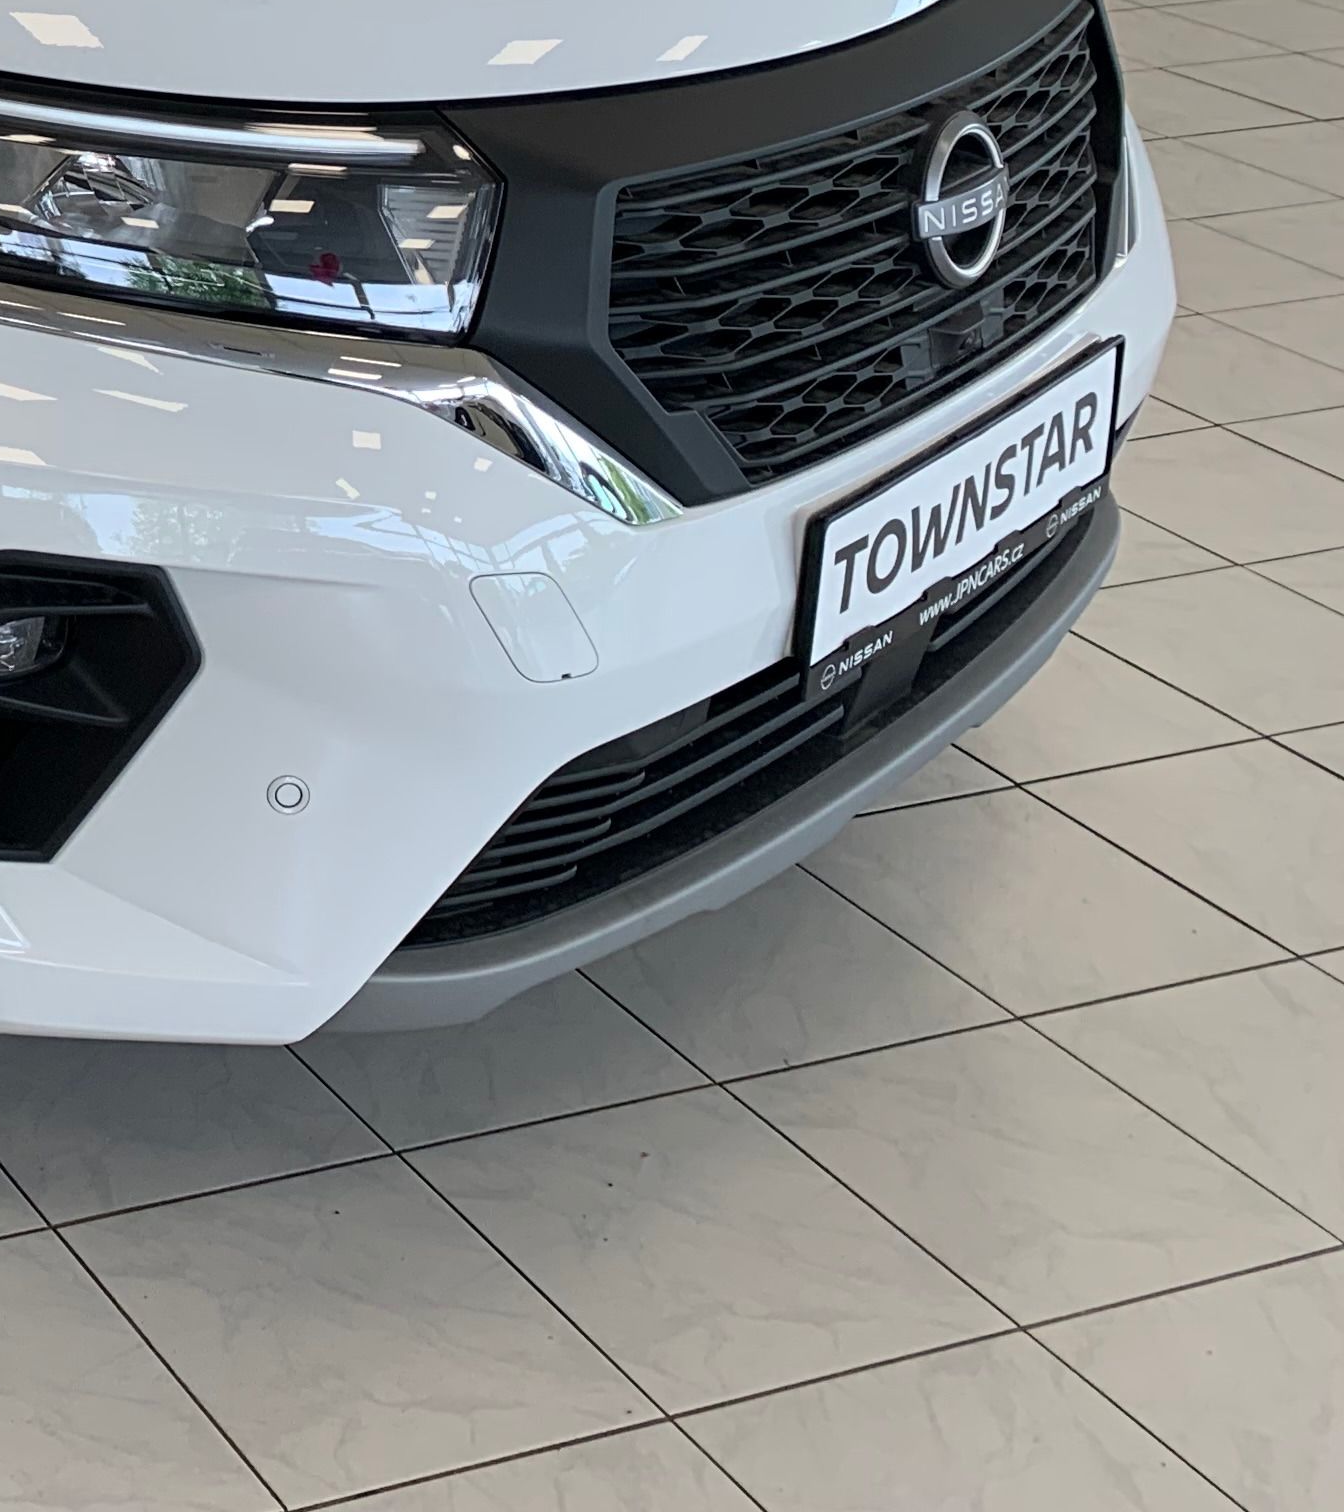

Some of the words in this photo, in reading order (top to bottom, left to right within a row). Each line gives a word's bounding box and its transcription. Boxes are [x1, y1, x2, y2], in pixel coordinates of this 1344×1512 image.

[923, 175, 1008, 233] NISSA
[834, 391, 1098, 615] TOWNSTAR
[1060, 486, 1102, 525] NISSAN
[919, 543, 1025, 626] www.JPNCARS.cz
[838, 631, 894, 675] NISSAN
